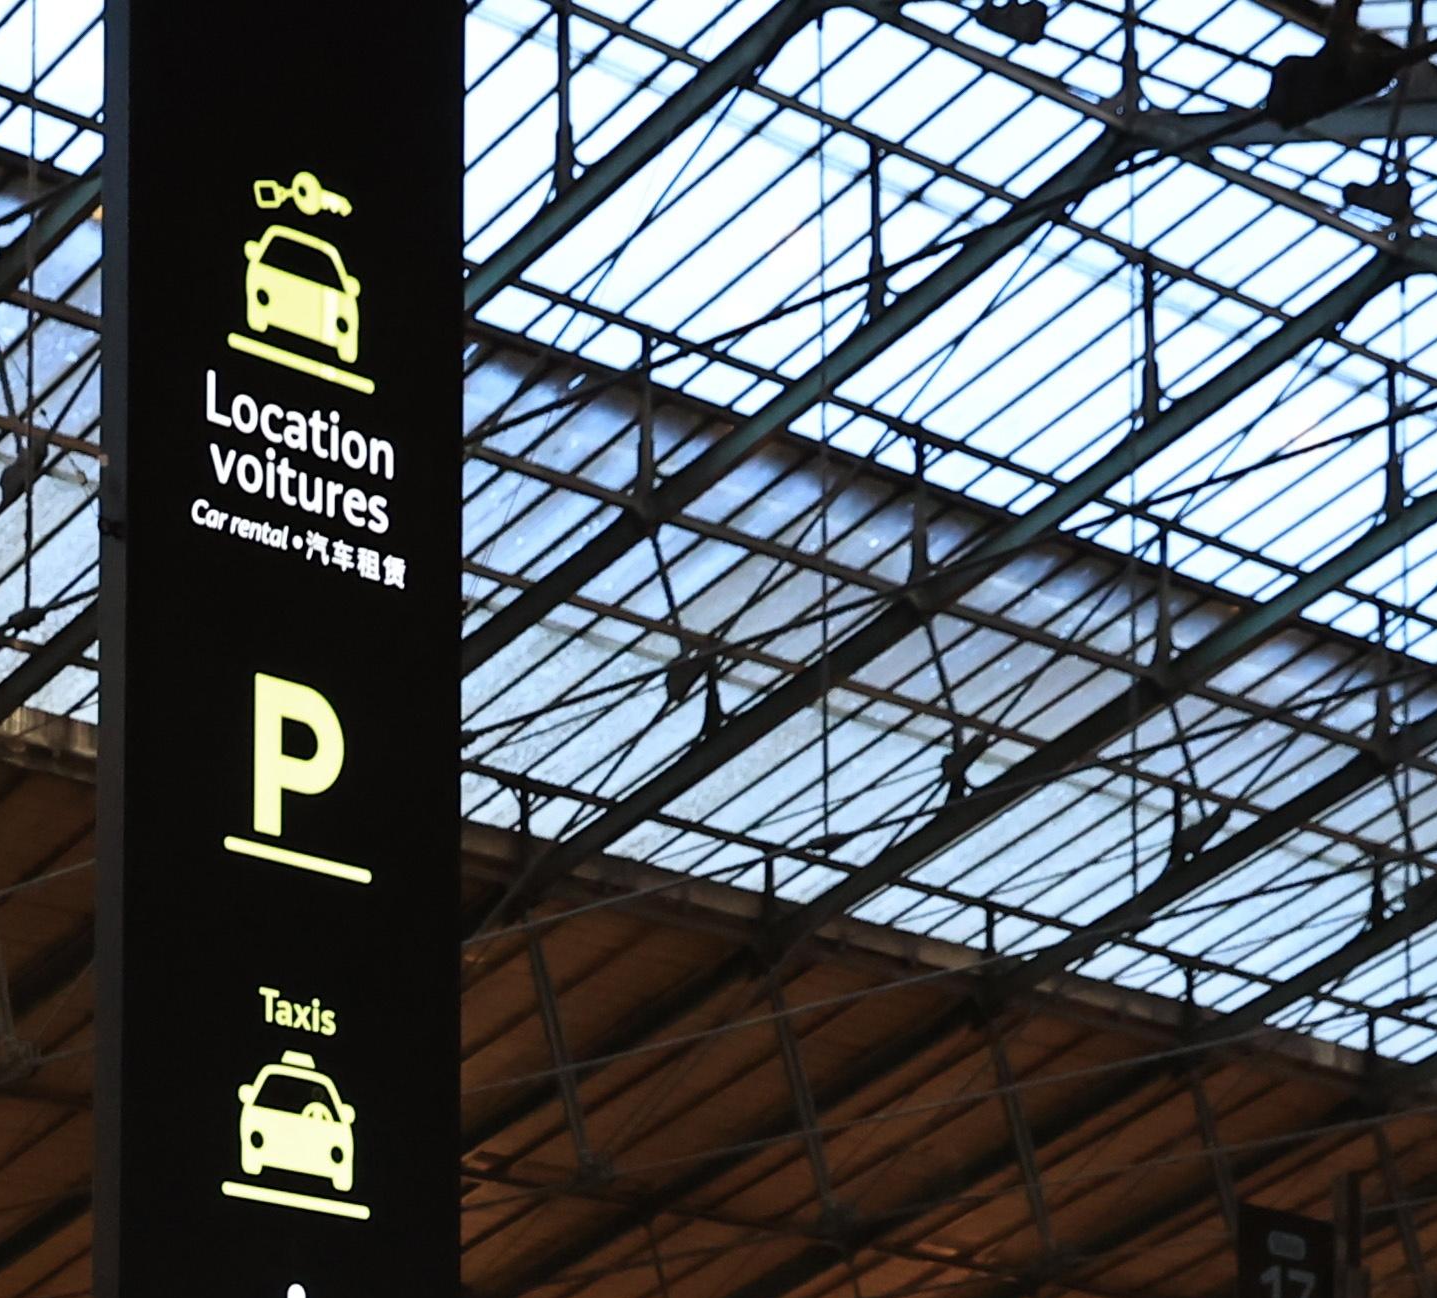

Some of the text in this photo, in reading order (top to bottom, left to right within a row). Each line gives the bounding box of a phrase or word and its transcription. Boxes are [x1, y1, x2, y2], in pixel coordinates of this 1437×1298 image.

[207, 369, 394, 480] Location
[191, 499, 289, 550] Car rental
[210, 443, 389, 534] voitures
[306, 530, 406, 589] 汽车租赁
[254, 672, 345, 836] P
[258, 986, 337, 1036] Taxis
